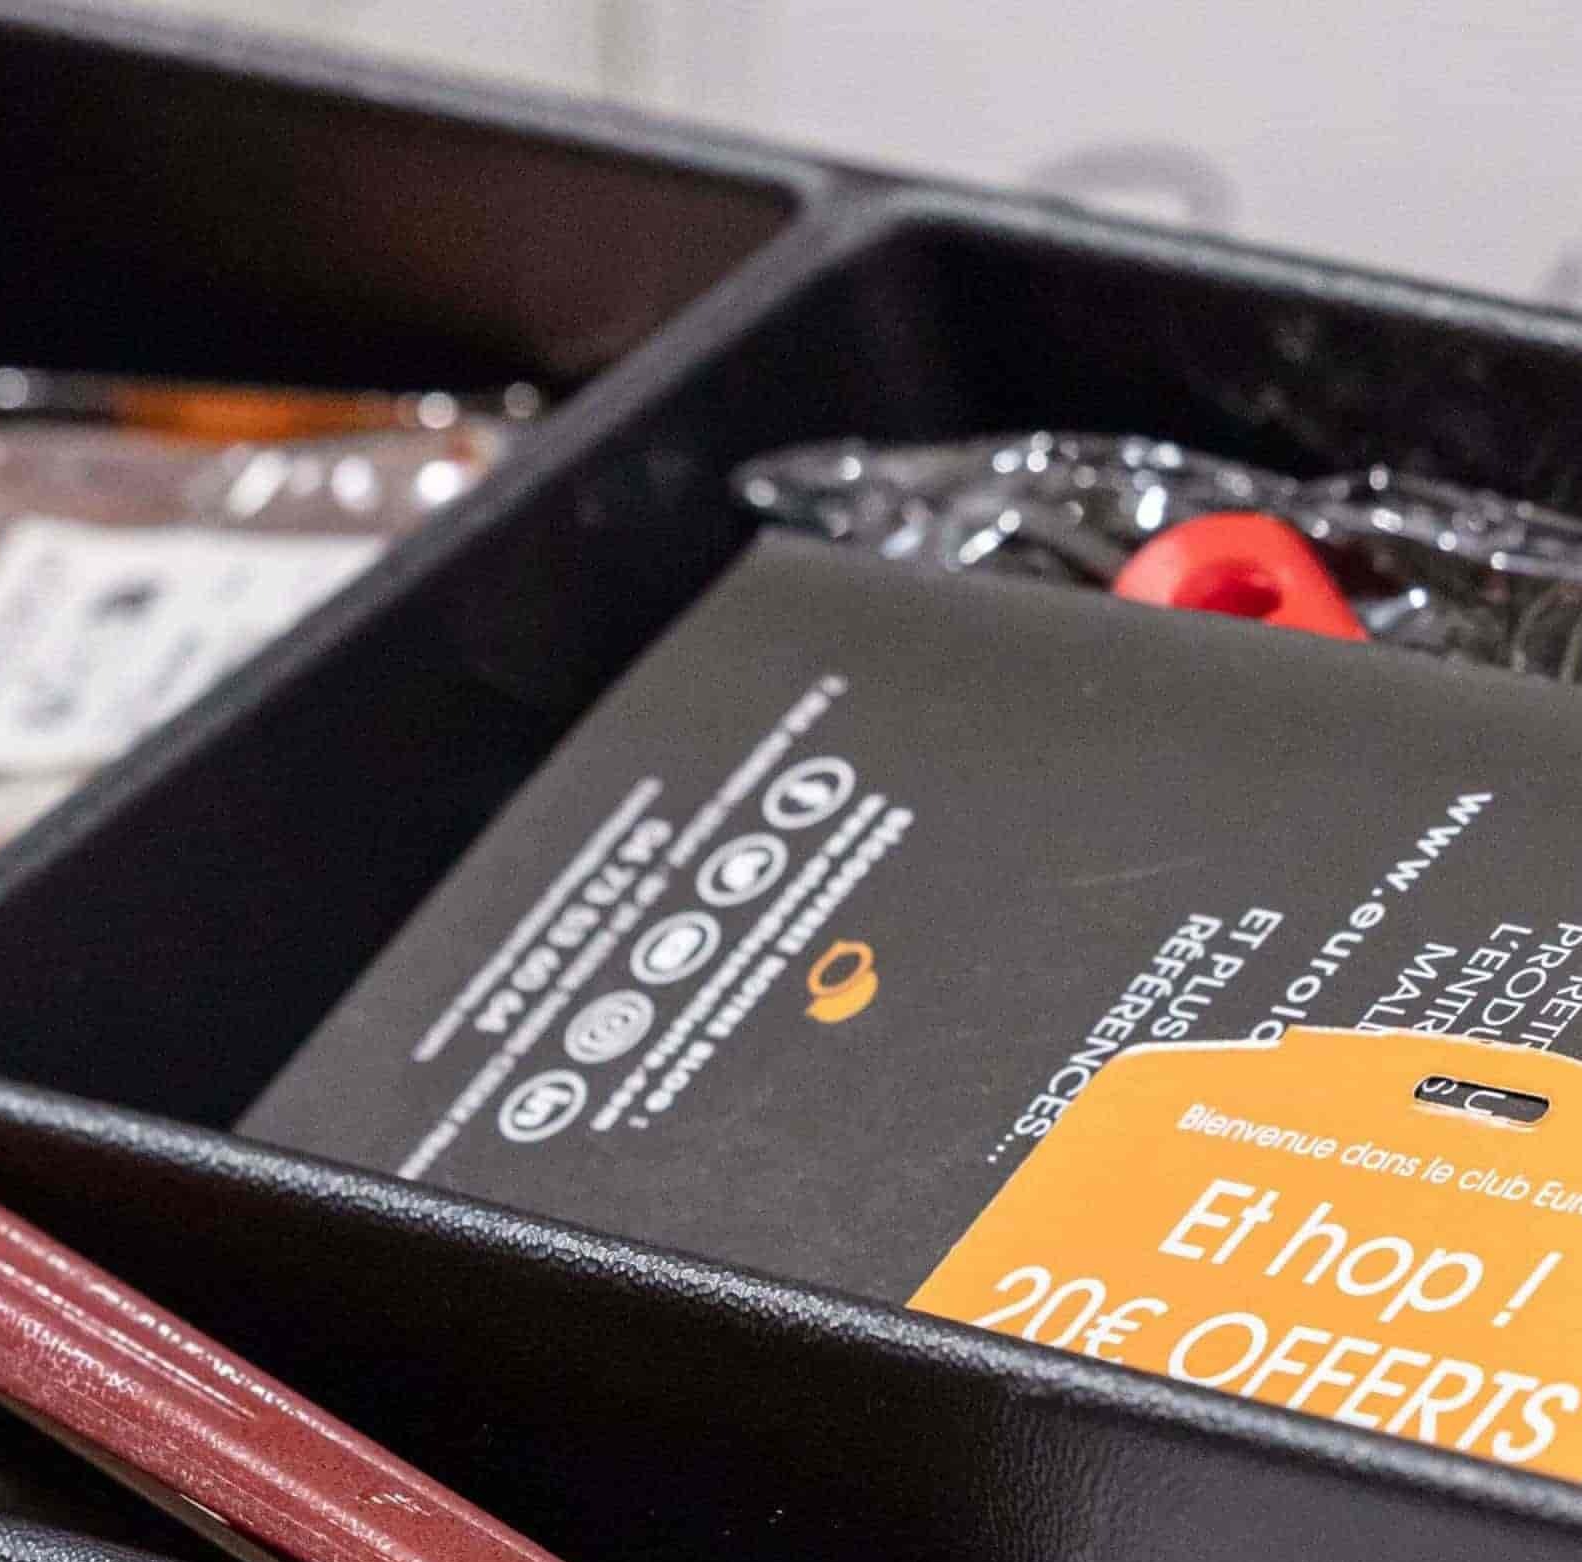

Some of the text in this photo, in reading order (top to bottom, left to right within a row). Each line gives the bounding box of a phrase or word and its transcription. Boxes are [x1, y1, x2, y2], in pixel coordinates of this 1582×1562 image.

[1150, 908, 1283, 1038] ET PLUS
[1176, 1103, 1339, 1160] Bienvenue
[1340, 1142, 1421, 1179] dans
[1422, 1156, 1455, 1184] le
[1457, 1167, 1530, 1201] club
[1158, 1179, 1562, 1327] Et hop !
[970, 1265, 1581, 1464] 20€ OFFERTS
